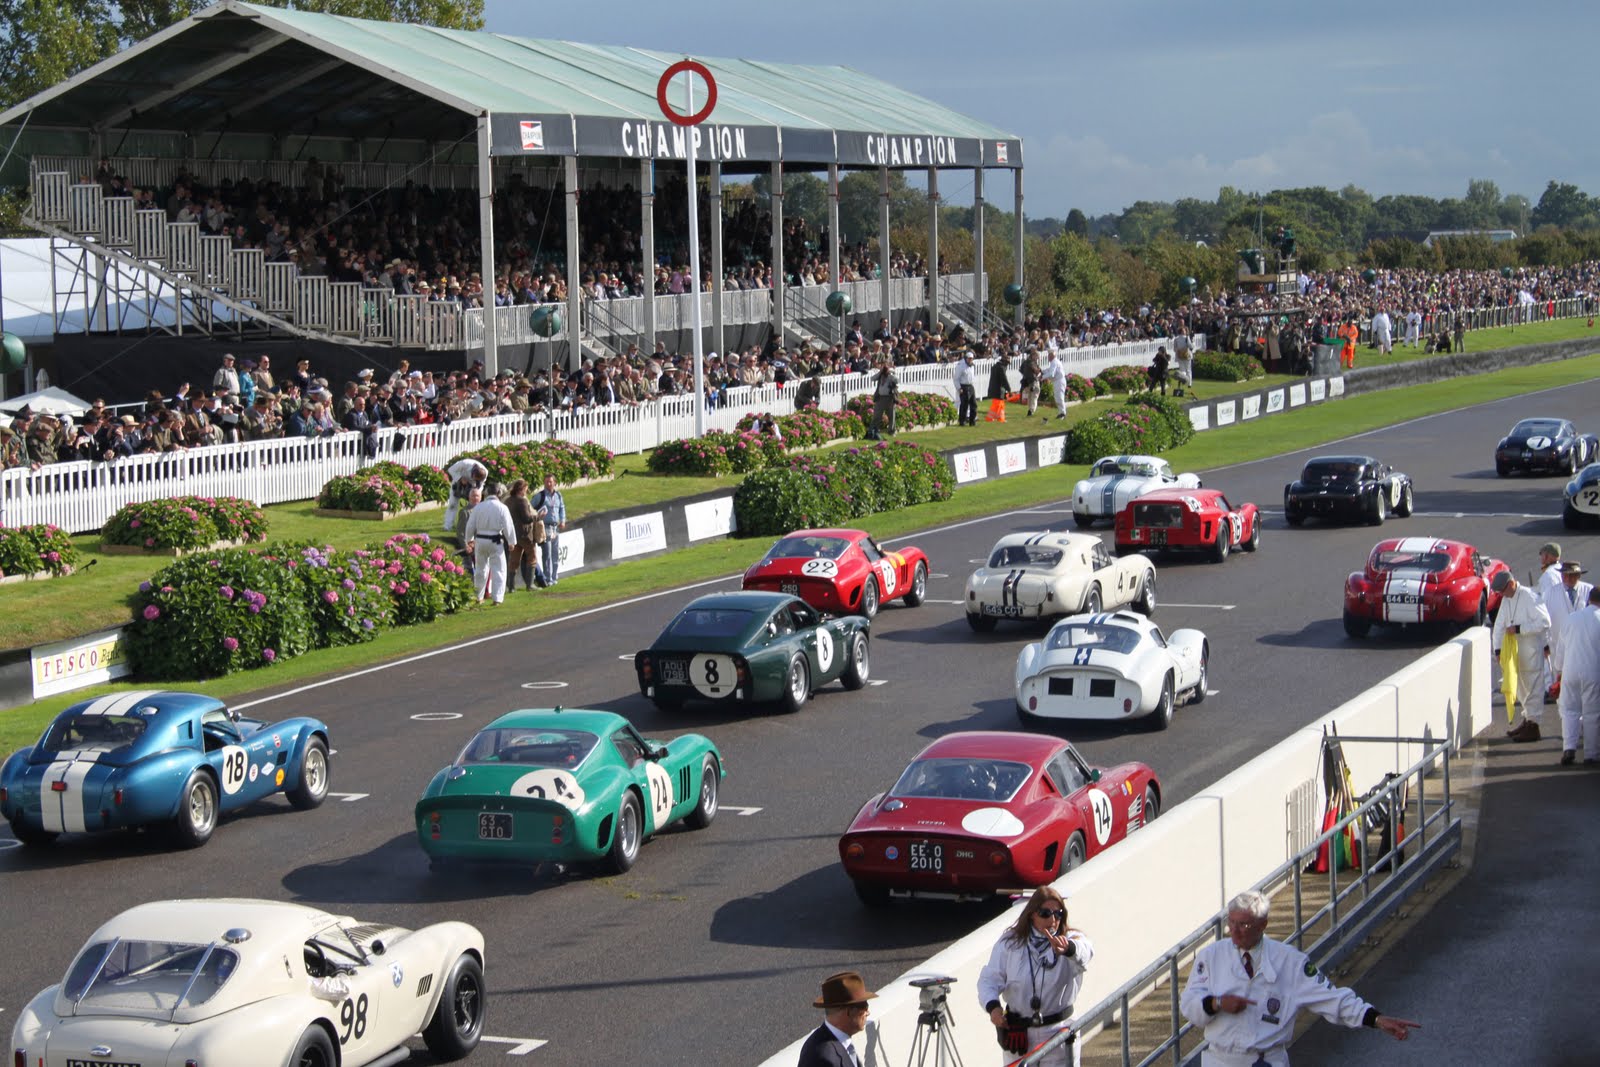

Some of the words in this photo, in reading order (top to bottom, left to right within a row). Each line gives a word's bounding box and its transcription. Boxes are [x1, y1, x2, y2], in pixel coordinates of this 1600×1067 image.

[622, 121, 747, 159] CHAMPION
[867, 135, 956, 165] CHAMPION
[806, 561, 835, 575] 22
[782, 584, 798, 592] 250
[1386, 595, 1402, 603] 644
[822, 636, 829, 661] 8
[43, 650, 98, 677] TESCO
[705, 659, 719, 684] 8
[226, 751, 244, 784] 18
[653, 775, 668, 813] 24
[480, 815, 496, 825] 63
[1095, 797, 1110, 835] 14
[480, 827, 504, 839] GTO
[911, 844, 926, 856] EE
[911, 857, 942, 869] 2010
[340, 993, 368, 1045] 98
